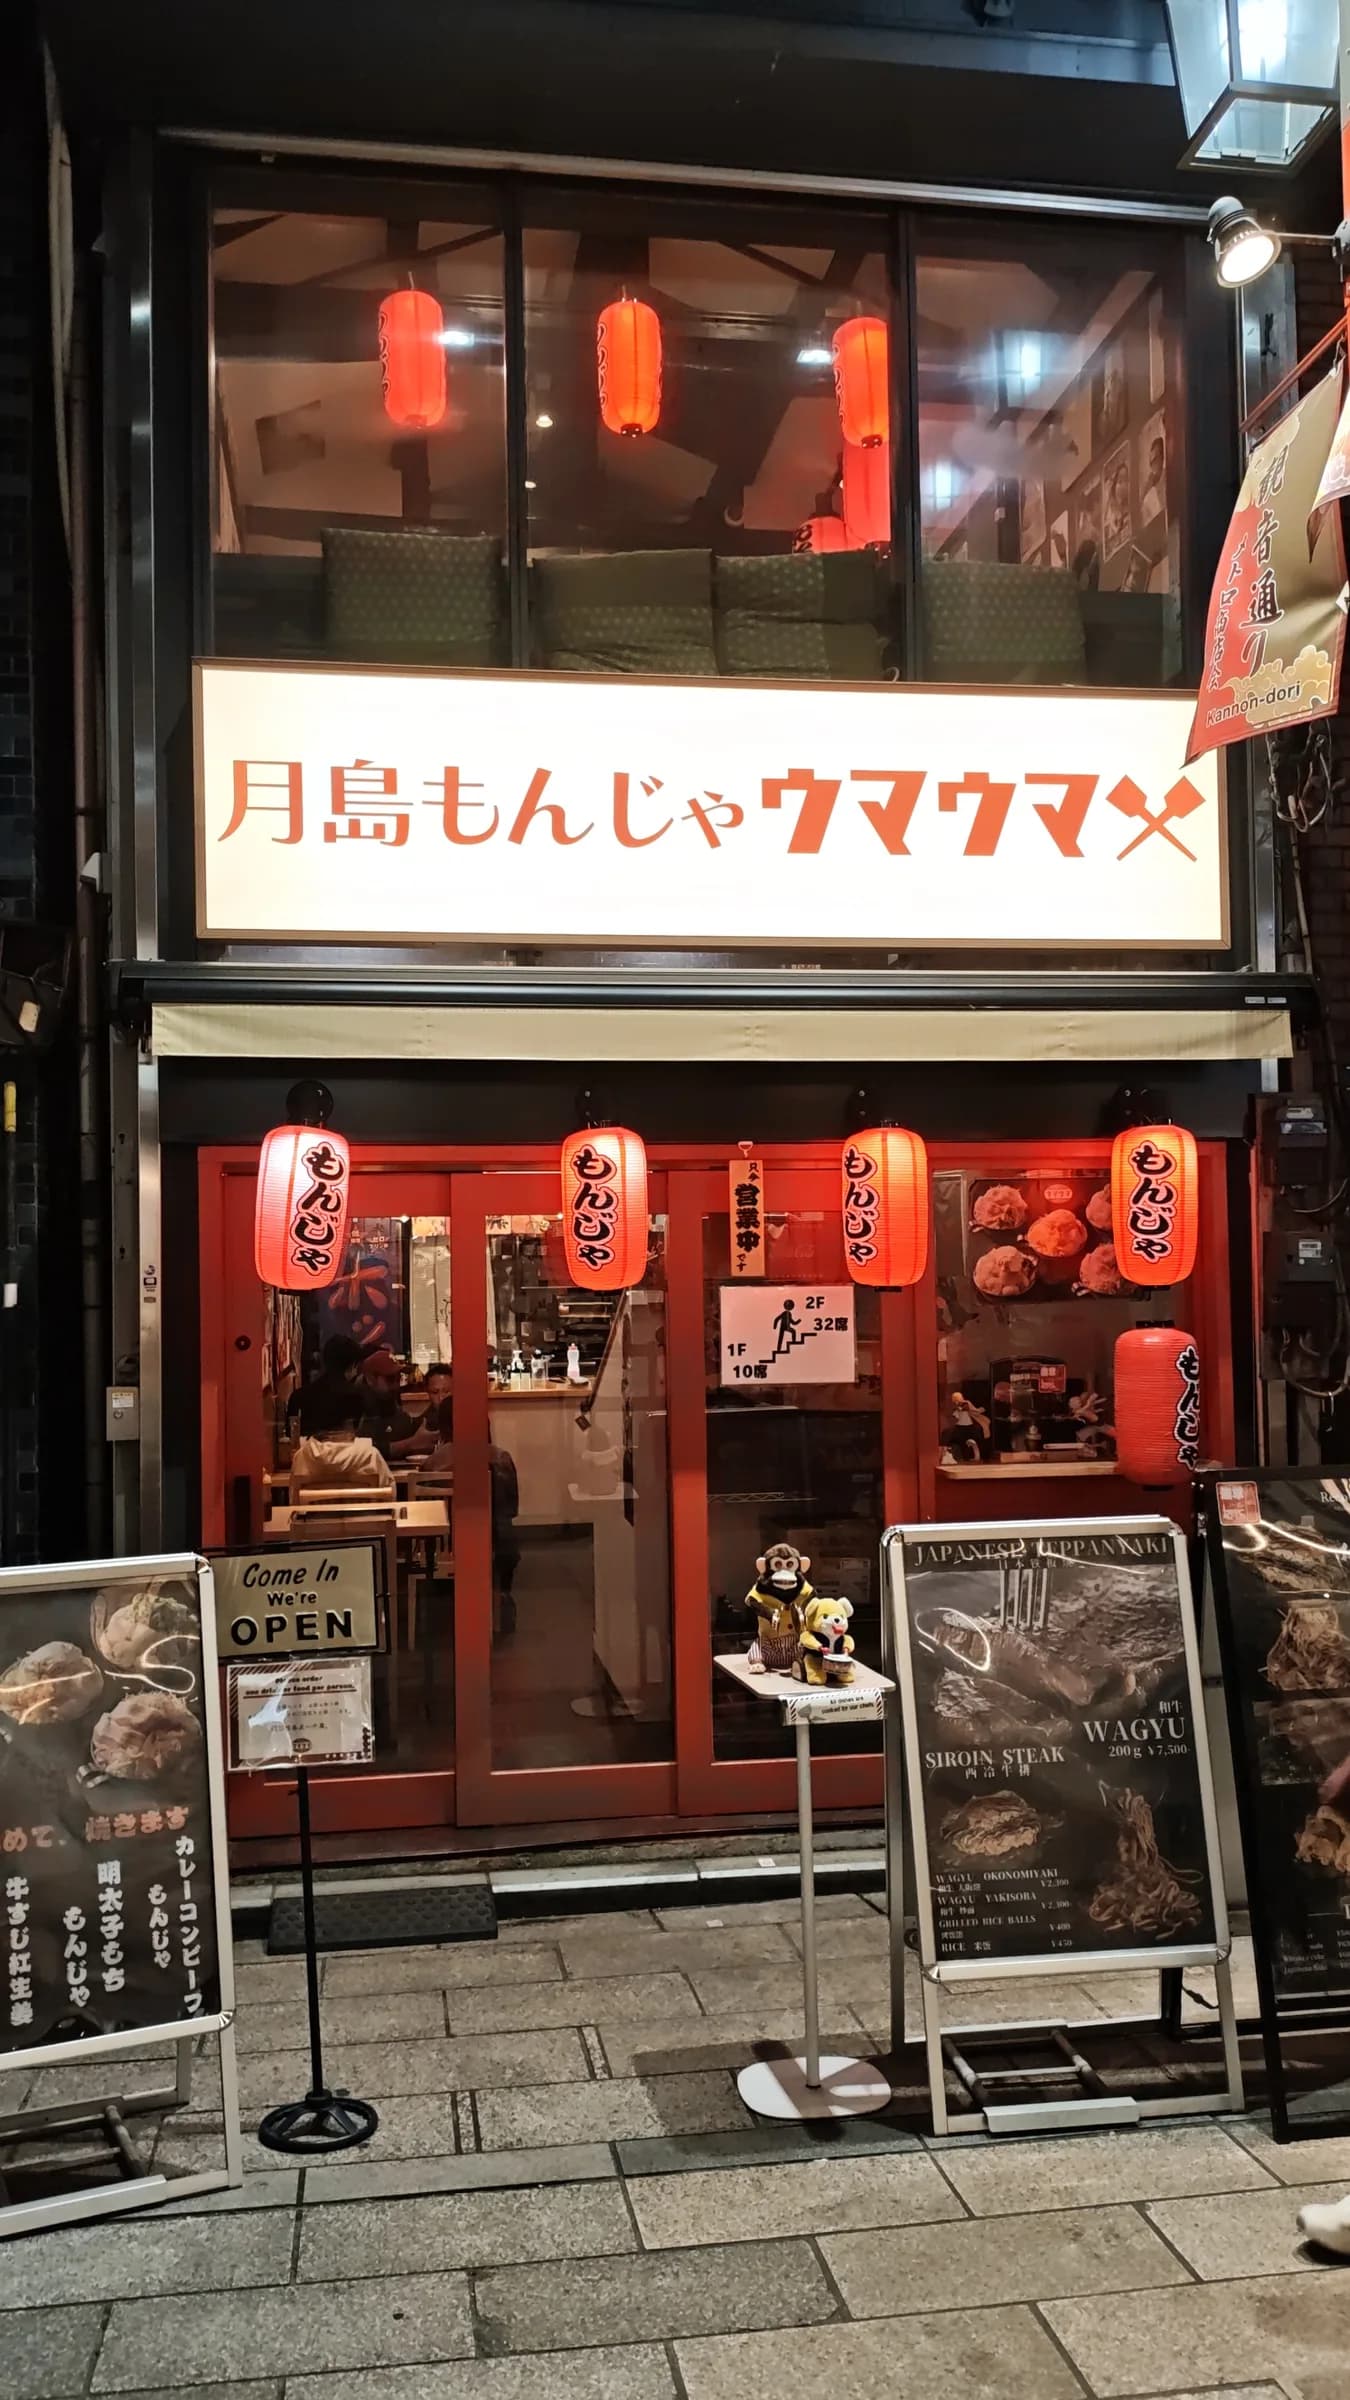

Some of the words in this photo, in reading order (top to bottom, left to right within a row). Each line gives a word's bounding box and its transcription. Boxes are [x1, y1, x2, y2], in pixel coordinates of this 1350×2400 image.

[1206, 681, 1300, 727] Kannon-dori
[805, 1296, 825, 1309] 2F
[813, 1318, 848, 1331] 32席
[728, 1343, 747, 1356] 1F
[733, 1365, 768, 1378] 10席
[914, 1542, 1023, 1566] JAPANESE
[1031, 1537, 1169, 1557] TEPPANYAKI
[243, 1563, 307, 1588] Come
[316, 1558, 340, 1582] In
[267, 1592, 318, 1607] We're
[231, 1609, 353, 1646] OPEN
[1082, 1717, 1185, 1744] WAGYU
[925, 1749, 993, 1769] SIROIN
[1002, 1746, 1066, 1766] STEAK
[983, 1868, 1058, 1881] OKONOMIYAKI
[97, 1860, 126, 1993] 明太子もち
[148, 1884, 172, 1968] もんじゃ
[175, 1835, 203, 2013] カレーコンビーフ
[1008, 1915, 1037, 1924] BALLS
[63, 1906, 91, 2008] もんじゃ
